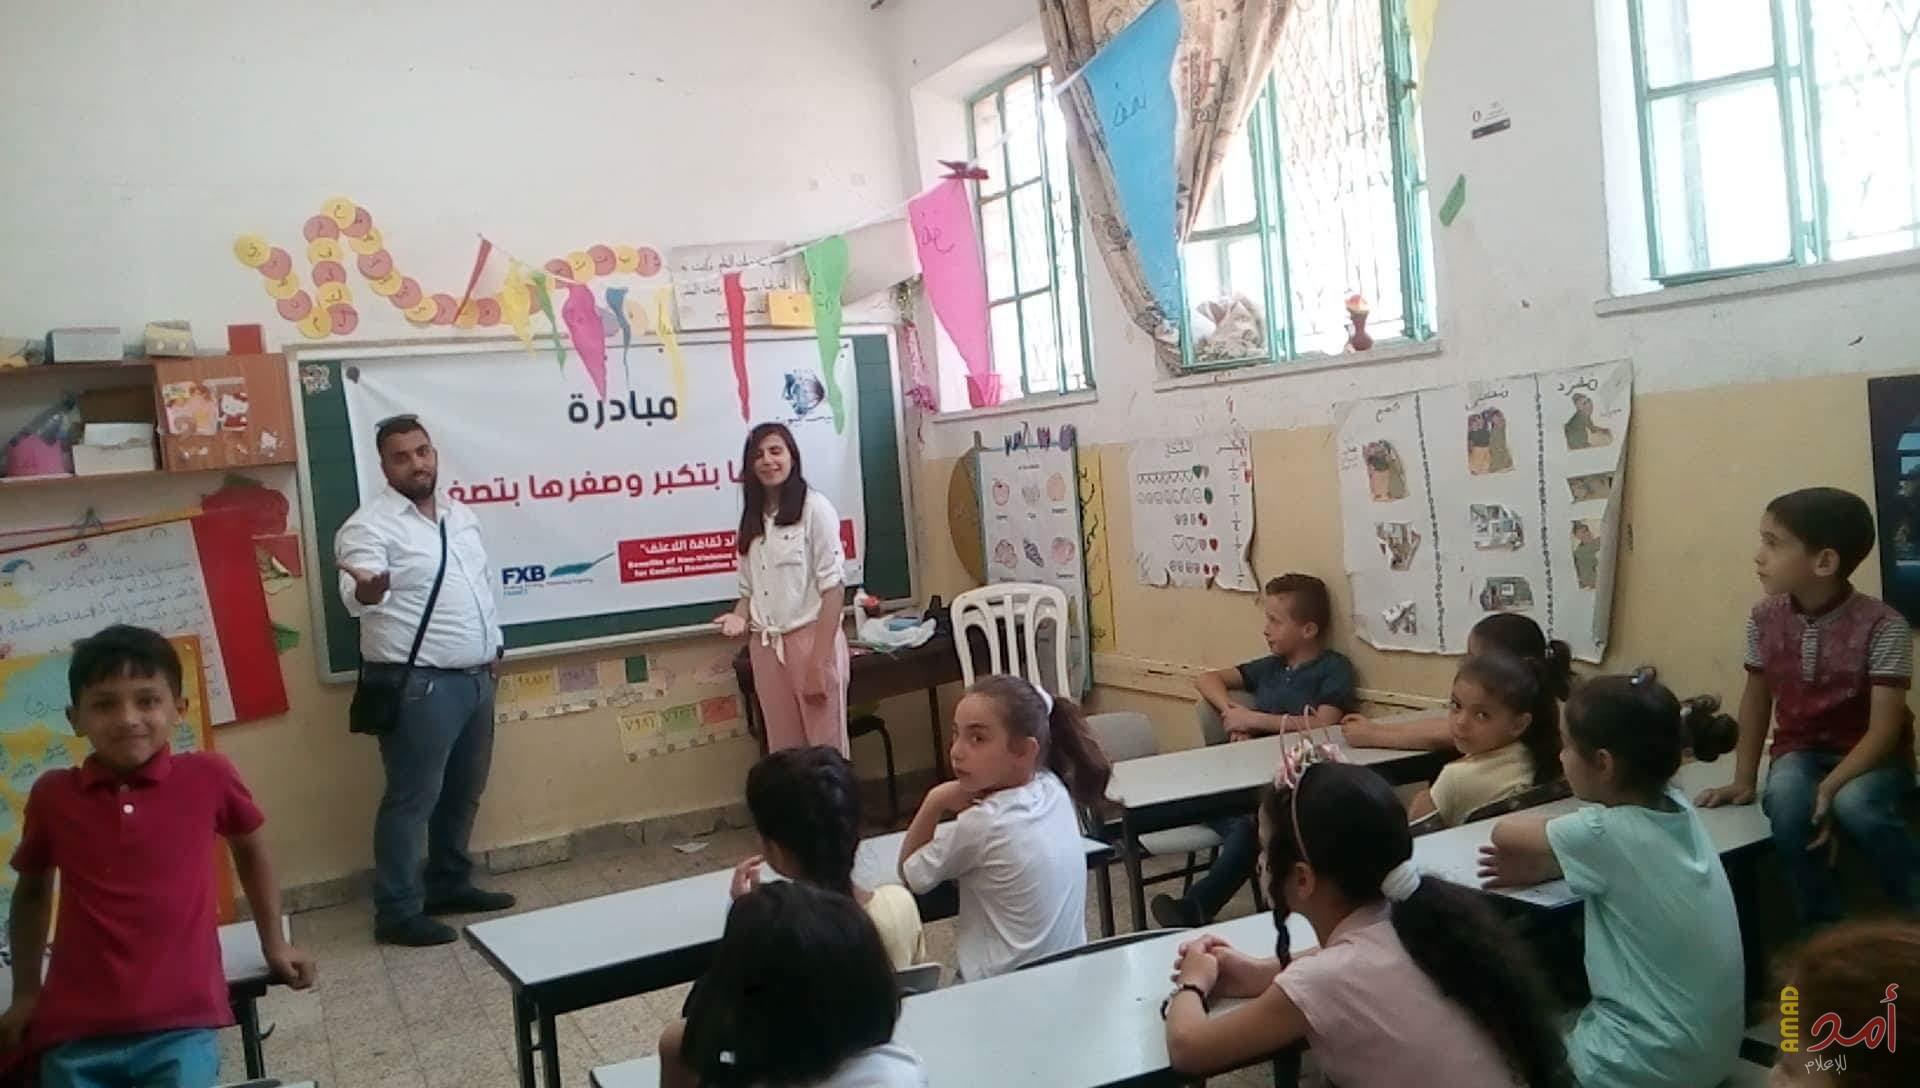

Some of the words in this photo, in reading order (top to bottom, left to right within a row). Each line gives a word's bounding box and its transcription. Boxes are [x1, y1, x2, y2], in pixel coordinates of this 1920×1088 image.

[567, 389, 679, 431] مبادرة
[448, 477, 520, 507] بتصغ
[528, 470, 643, 502] وصغرها
[653, 462, 721, 496] بتكبر
[501, 565, 546, 585] FXB
